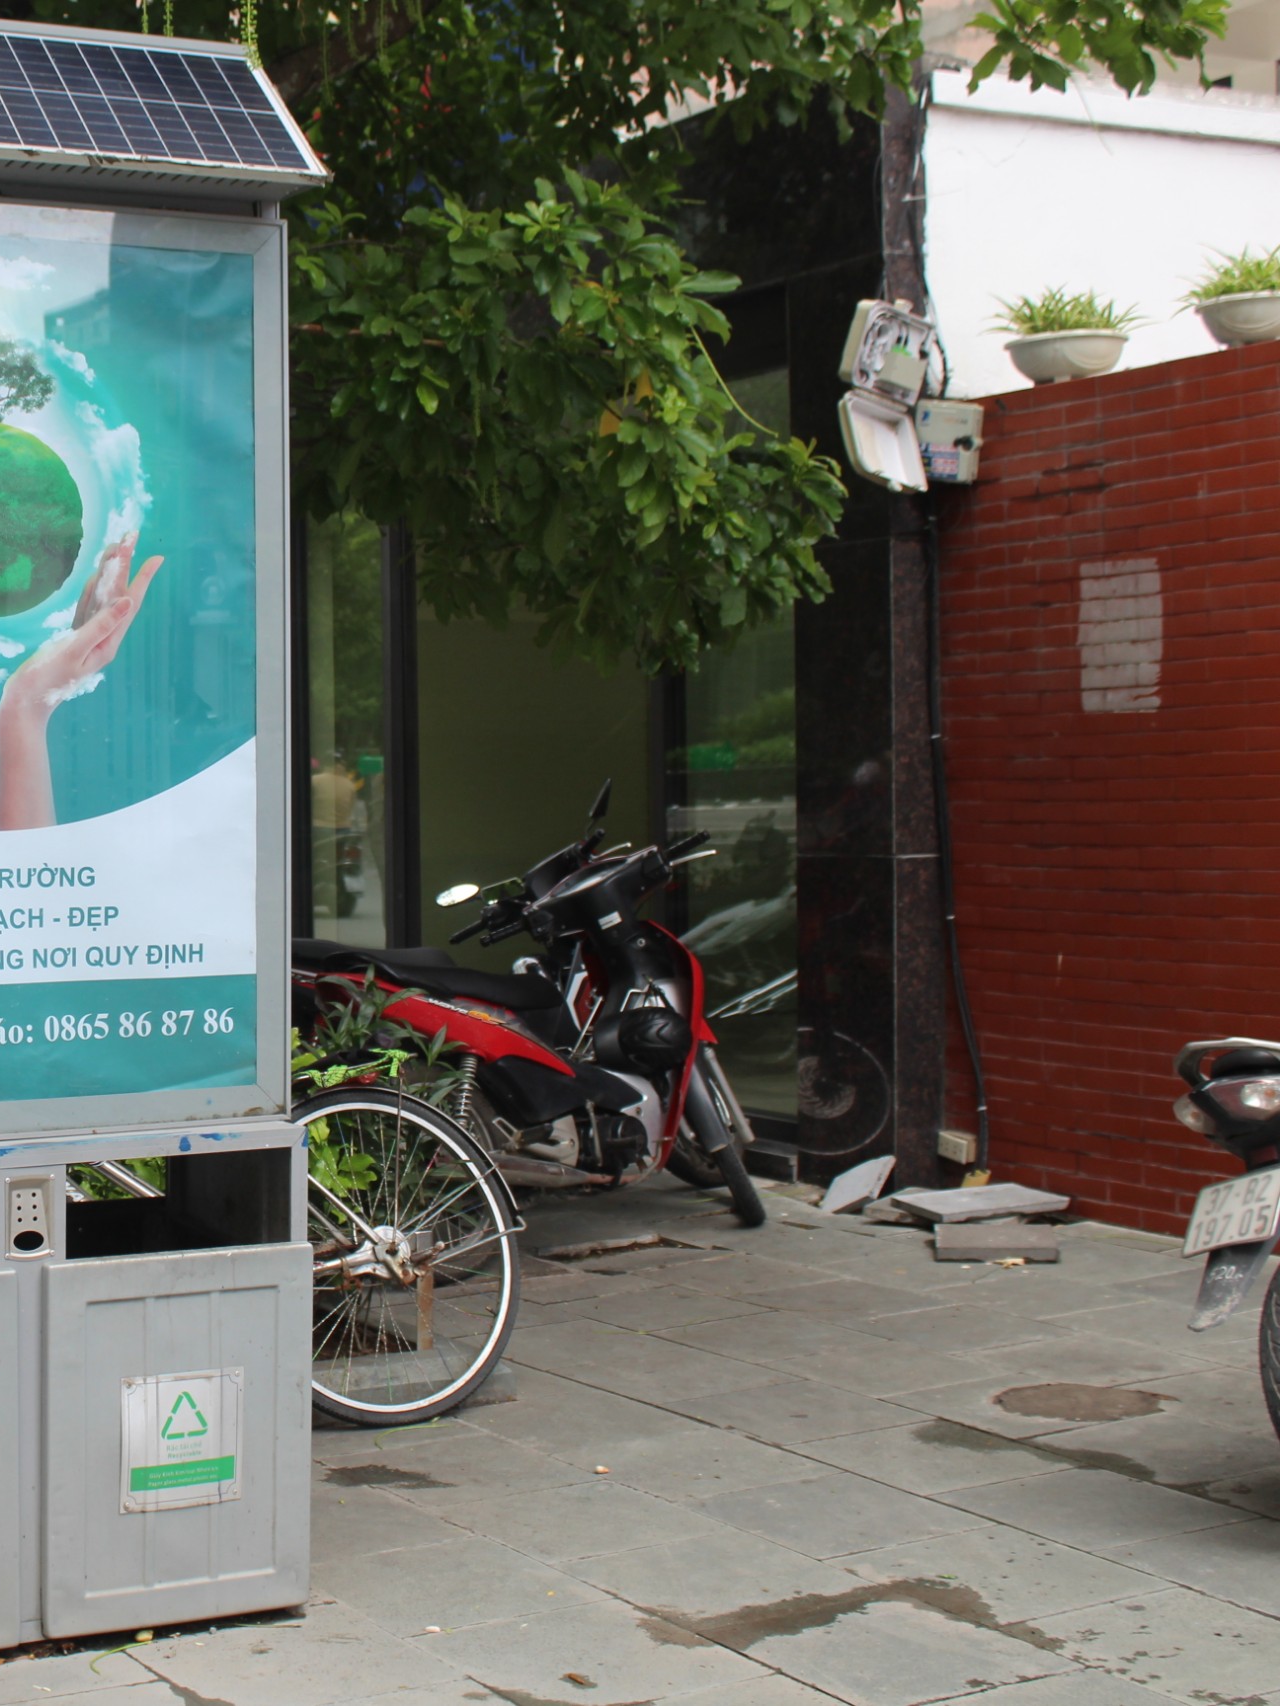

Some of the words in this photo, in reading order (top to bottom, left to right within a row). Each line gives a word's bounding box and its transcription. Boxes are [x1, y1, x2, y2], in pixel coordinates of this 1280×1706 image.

[67, 906, 119, 931] ĐẸP
[32, 947, 77, 969] NƠI
[85, 945, 139, 968] QUY
[145, 943, 204, 969] ĐỊNH
[44, 1013, 109, 1043] 0865
[118, 1010, 152, 1038] 86
[161, 1009, 195, 1036] 87
[203, 1007, 234, 1035] 86
[1192, 1204, 1271, 1250] 197.05
